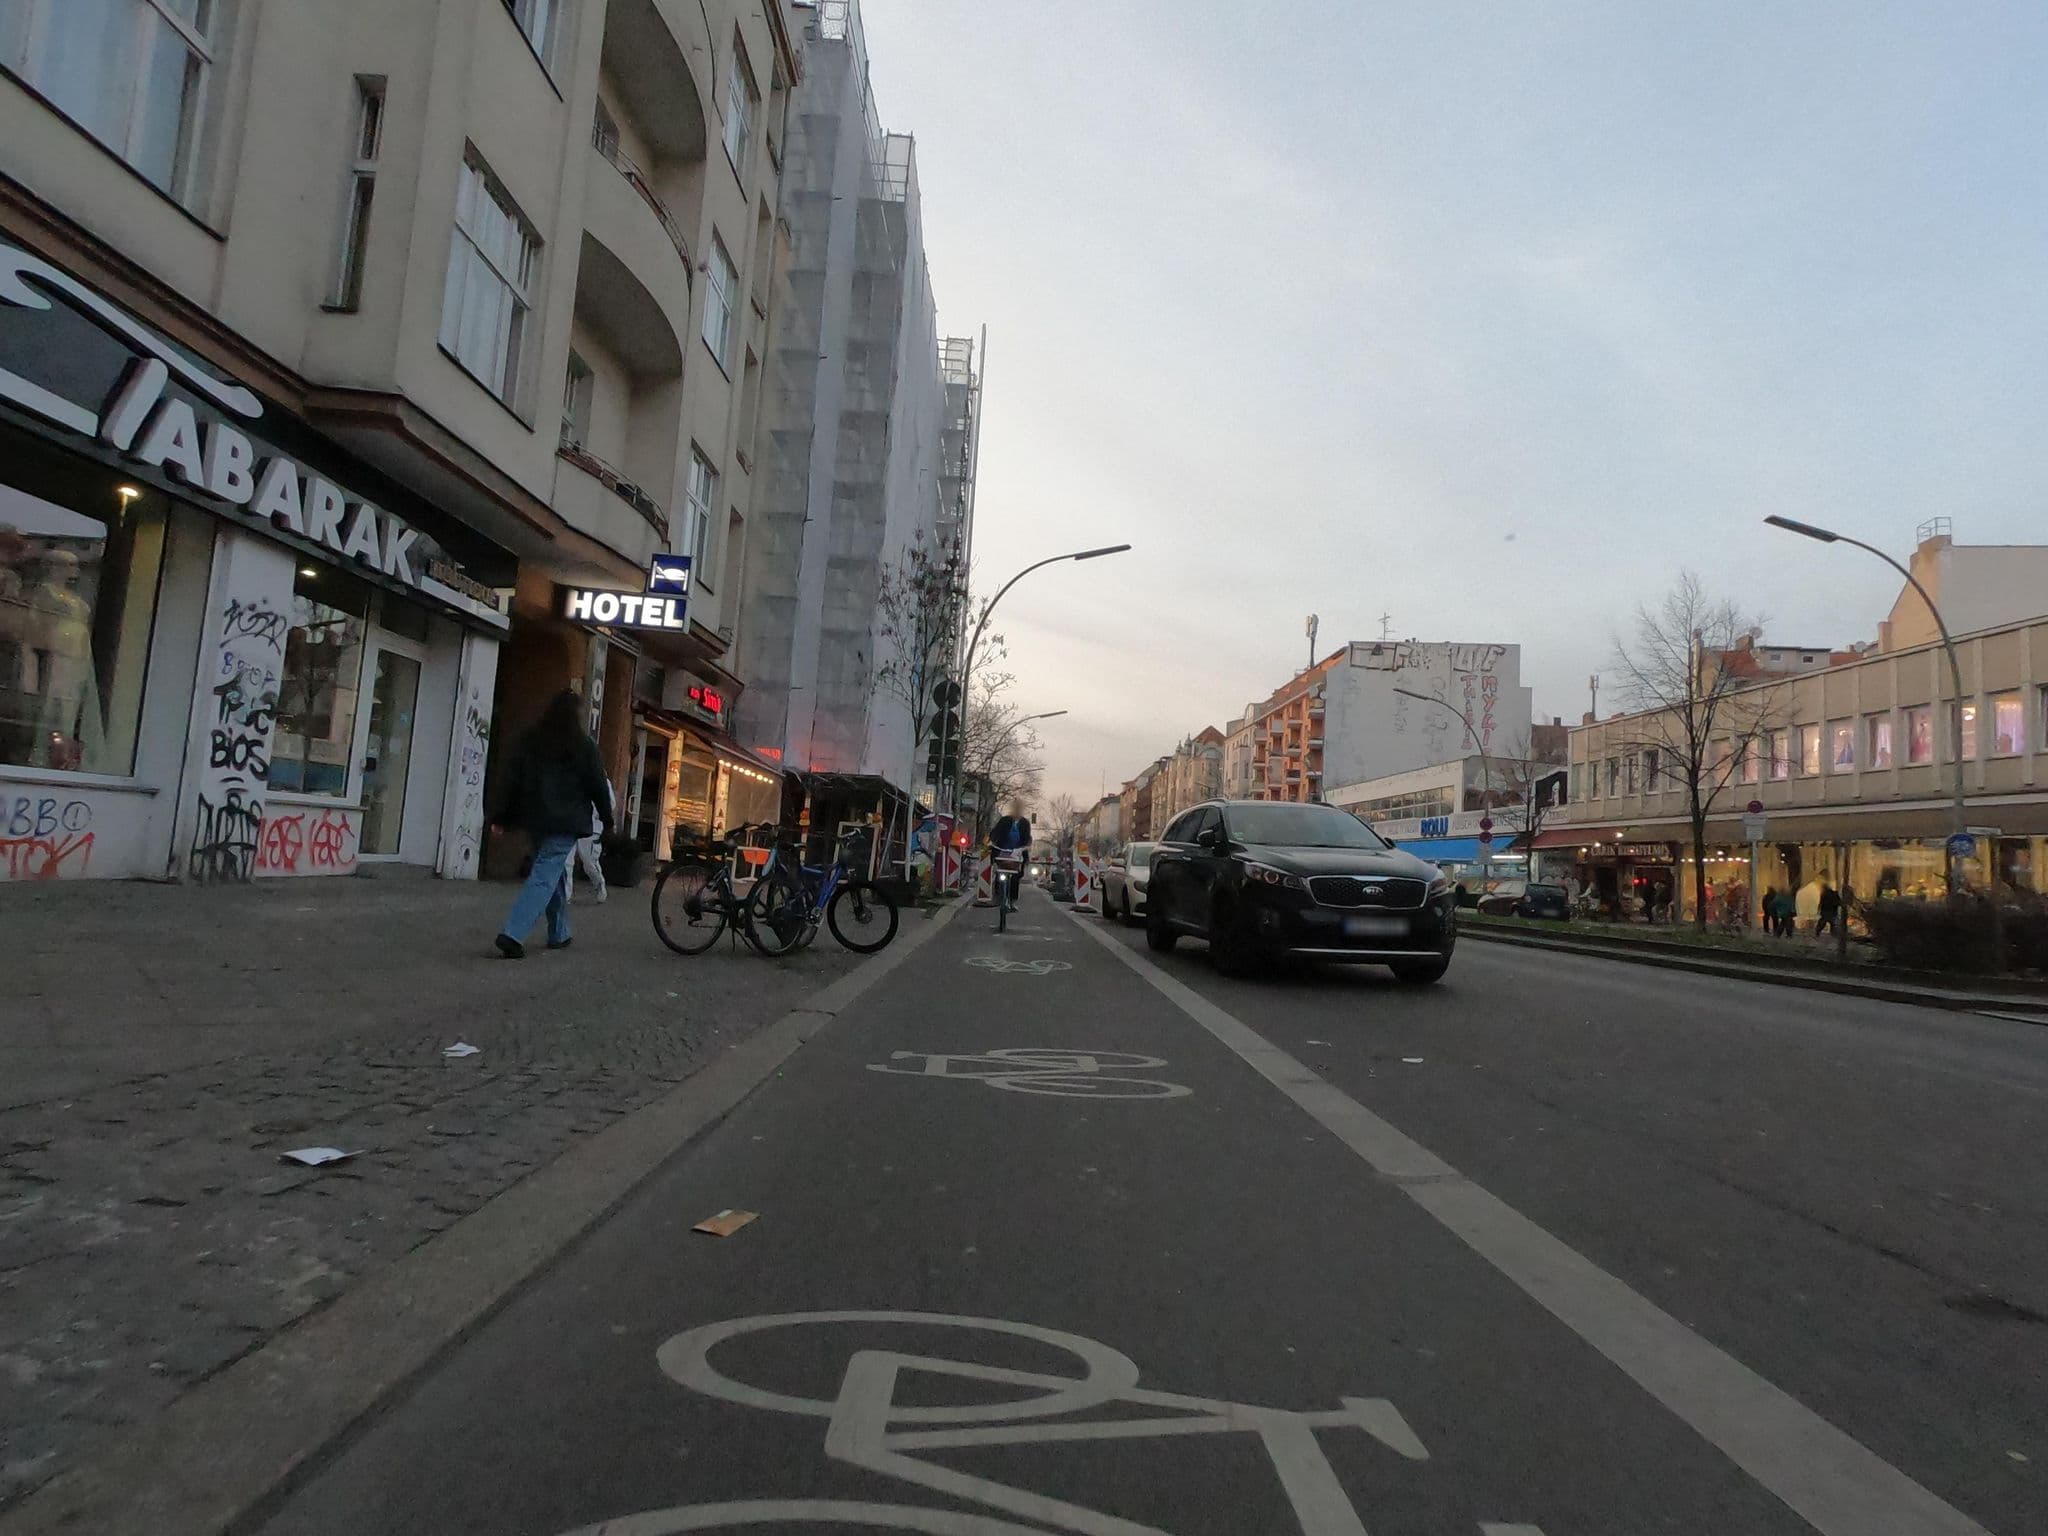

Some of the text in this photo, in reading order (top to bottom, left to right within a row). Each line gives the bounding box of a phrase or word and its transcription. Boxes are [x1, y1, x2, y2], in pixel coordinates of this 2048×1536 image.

[20, 266, 418, 587] TABARAK
[565, 589, 684, 629] HOTEL
[1420, 816, 1449, 837] BOLU
